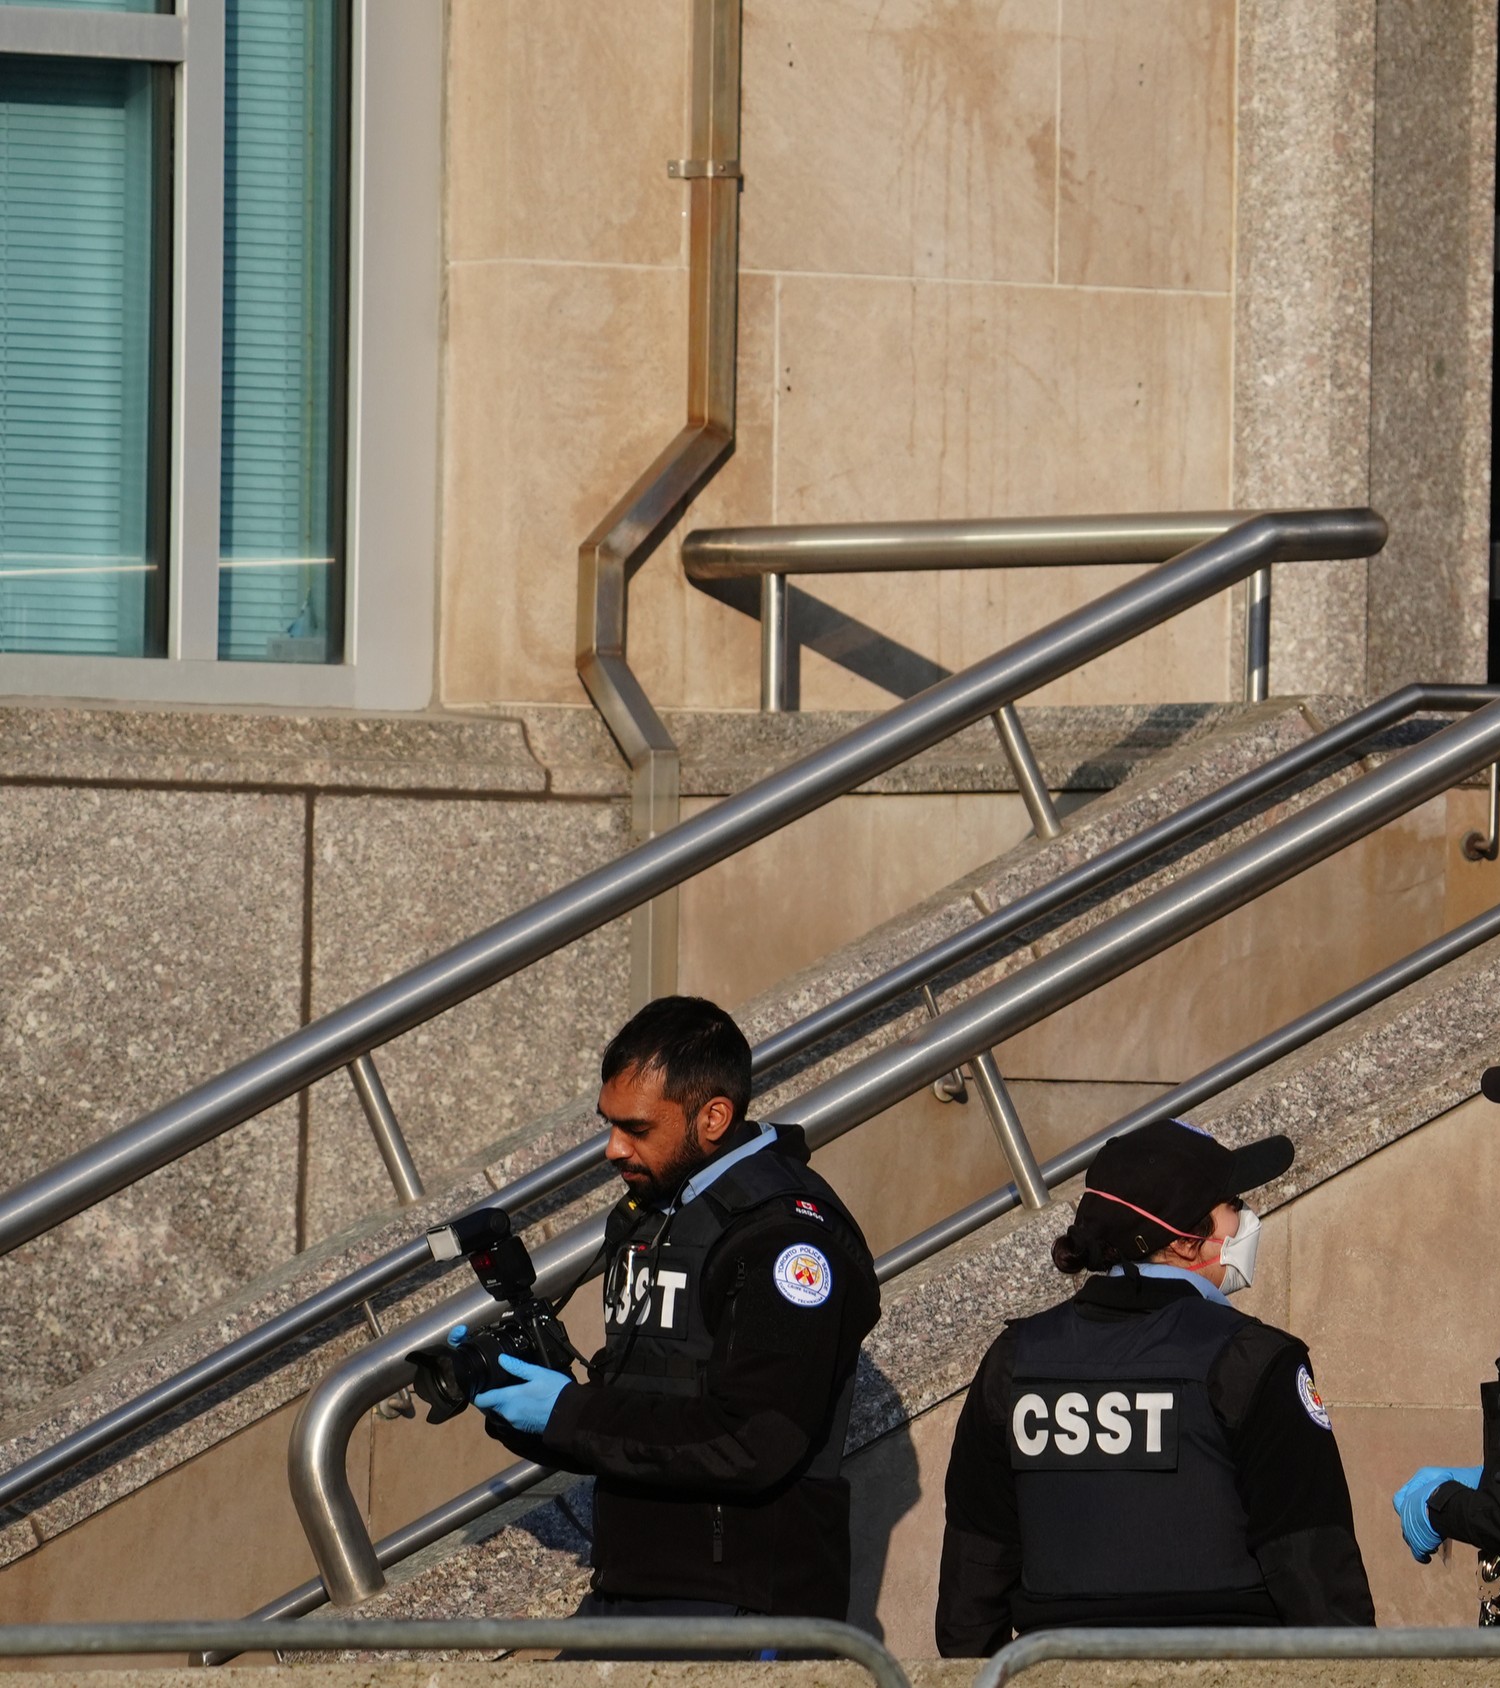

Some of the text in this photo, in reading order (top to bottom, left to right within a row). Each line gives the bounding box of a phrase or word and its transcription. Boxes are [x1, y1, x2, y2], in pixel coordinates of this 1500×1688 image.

[778, 1248, 797, 1273] TORONTO
[800, 1247, 822, 1262] POLICE
[1012, 1391, 1174, 1456] CSST
